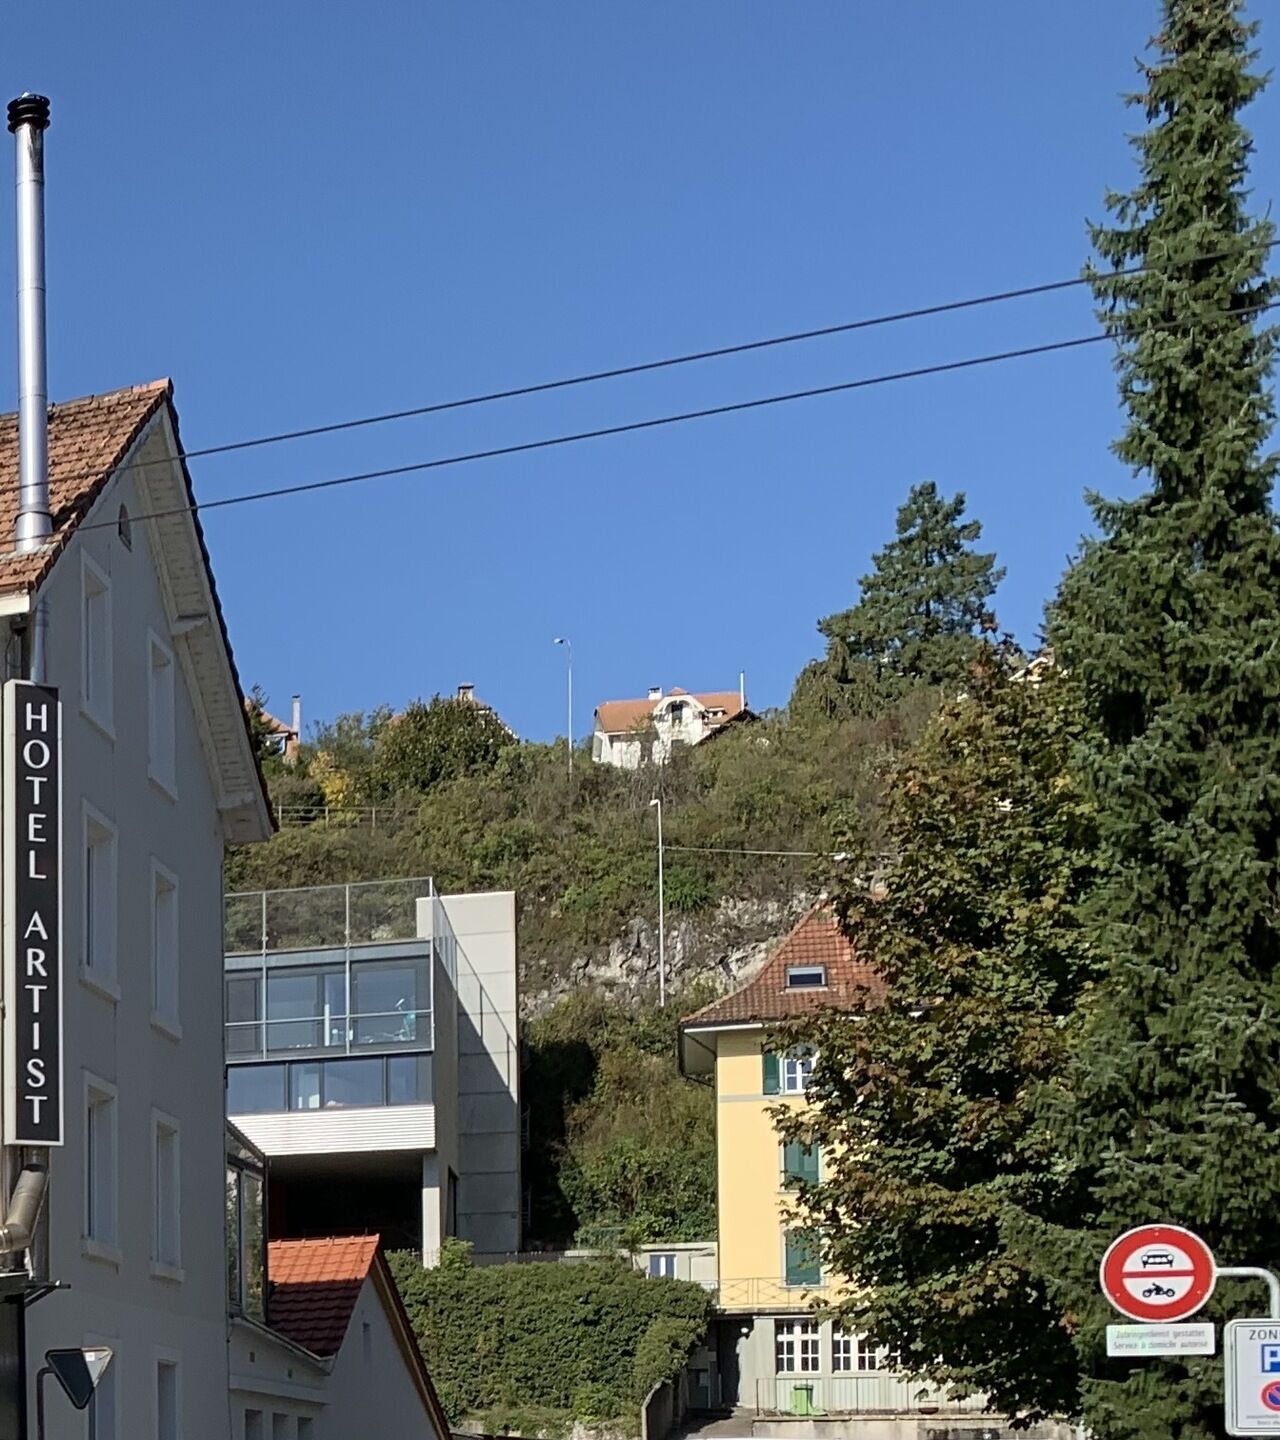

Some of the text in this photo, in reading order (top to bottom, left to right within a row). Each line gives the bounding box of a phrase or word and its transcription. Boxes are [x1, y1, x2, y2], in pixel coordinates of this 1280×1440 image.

[22, 701, 50, 1124] HOTEL ARTIST
[1249, 1329, 1280, 1340] ZON
